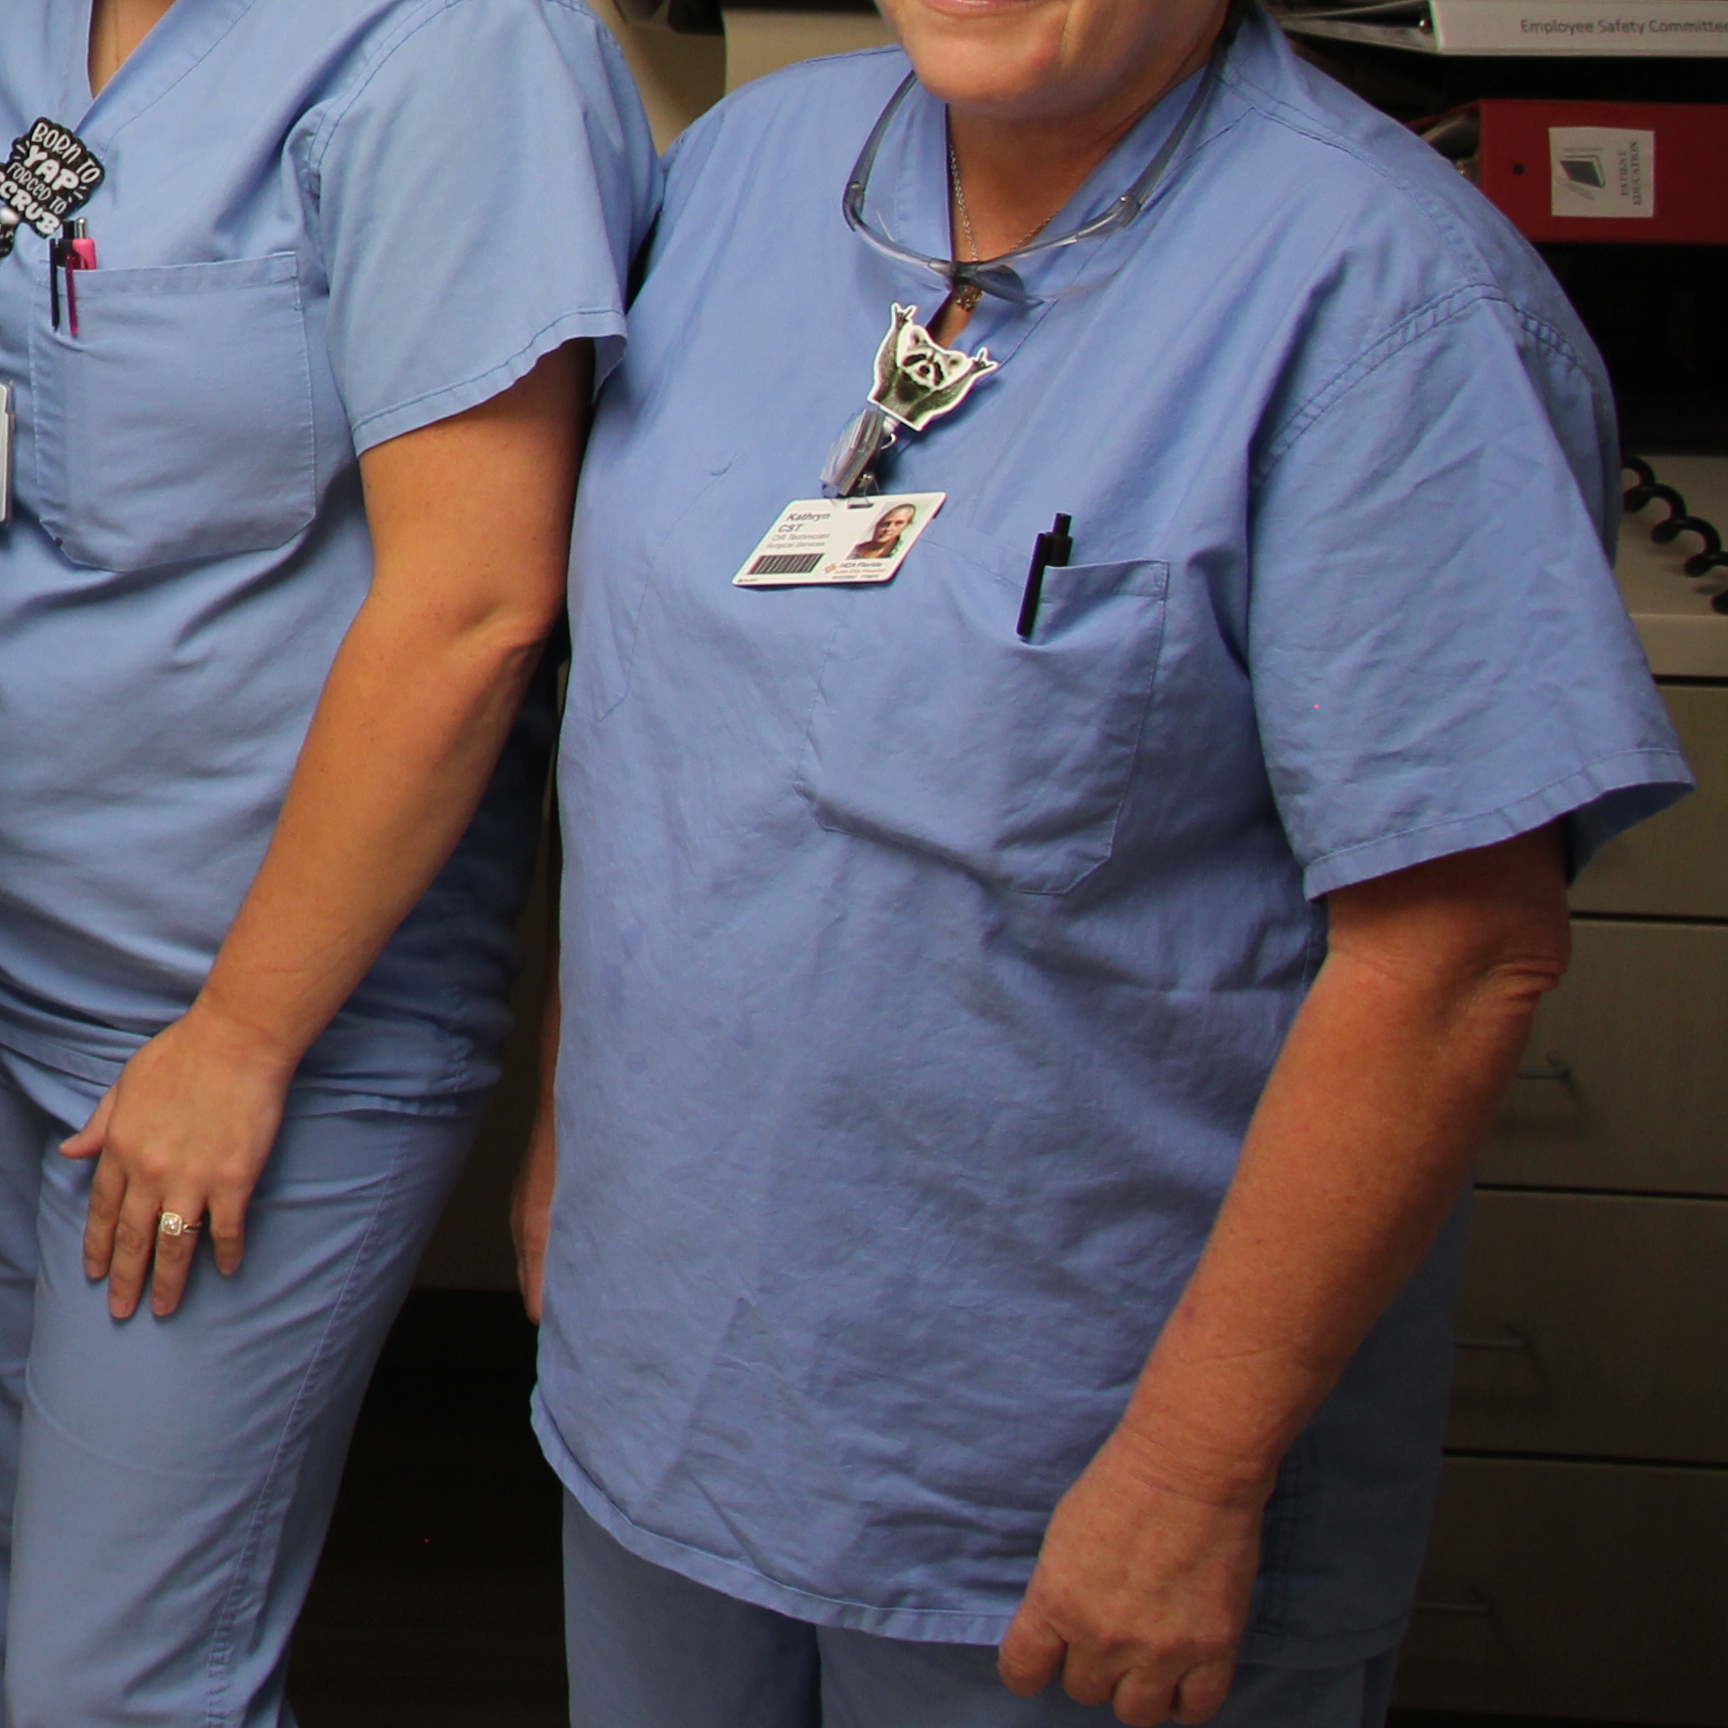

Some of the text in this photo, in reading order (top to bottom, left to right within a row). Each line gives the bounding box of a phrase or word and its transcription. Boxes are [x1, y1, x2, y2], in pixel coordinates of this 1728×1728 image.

[1520, 18, 1594, 35] Employee
[1597, 18, 1644, 35] Safety
[24, 145, 79, 191] YAP
[31, 122, 101, 183] BORN TO
[6, 162, 68, 214] FORCED TO
[777, 524, 803, 532] CST
